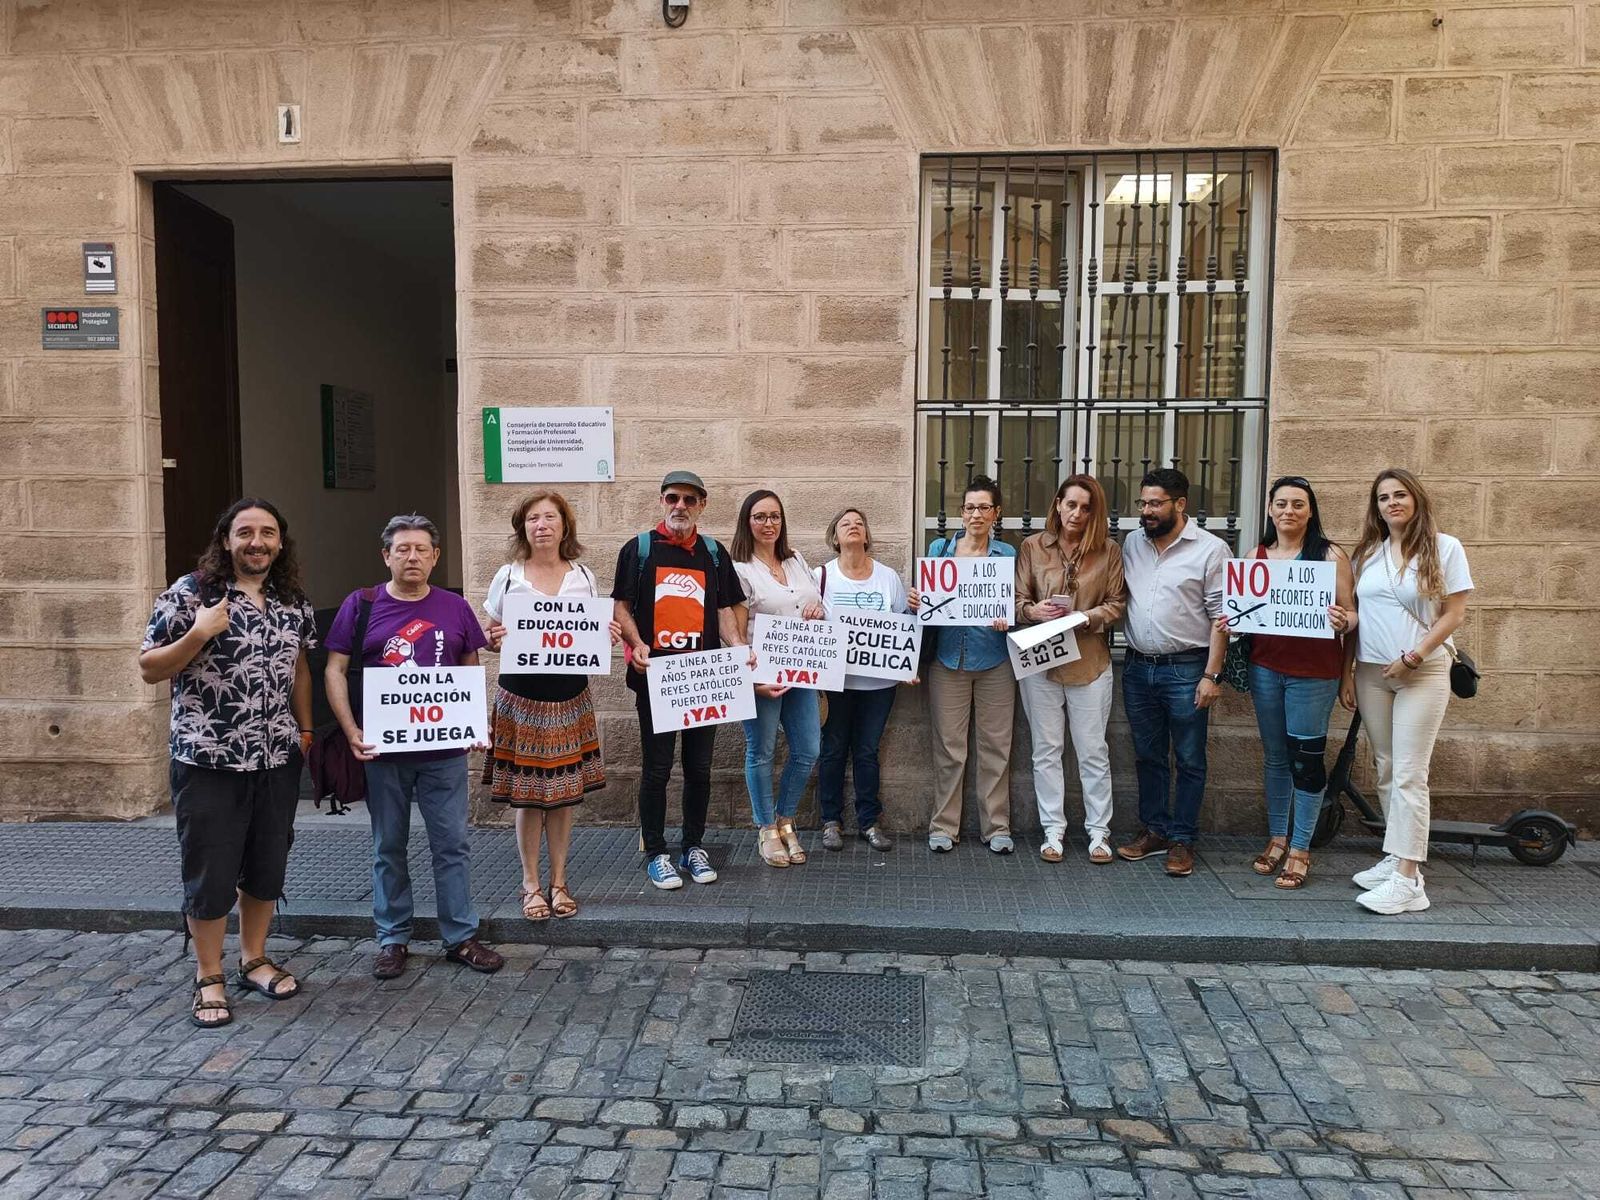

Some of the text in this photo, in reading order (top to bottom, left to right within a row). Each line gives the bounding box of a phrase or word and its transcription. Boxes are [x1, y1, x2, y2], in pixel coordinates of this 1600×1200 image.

[507, 421, 537, 429] Consejería
[507, 438, 538, 446] Consejería
[920, 559, 996, 592] NO A LOS
[1227, 561, 1315, 597] NO A LOS
[959, 584, 1012, 598] RECORTES EN
[1270, 589, 1332, 607] RECORTES EN
[534, 602, 585, 613] CON LA
[963, 600, 1007, 618] EDUCACIÓN
[518, 618, 599, 631] EDUCACIÓN
[785, 620, 809, 631] LÍNEA
[813, 624, 824, 634] DE
[828, 625, 832, 634] 3
[840, 615, 915, 632] SALVEMOS LA
[1275, 609, 1325, 629] EDUCACIÓN
[542, 632, 573, 648] NO
[657, 630, 702, 650] CGT
[765, 631, 837, 646] AÑOS PARA CEIP
[848, 630, 915, 652] SCUELA
[762, 643, 837, 658] REYES CATÓLICOS
[846, 647, 912, 671] ÚBLICA
[517, 653, 600, 667] SE JUEGA
[680, 656, 707, 668] LÍNEA
[711, 653, 722, 664] DE
[726, 652, 732, 662] 3
[769, 656, 828, 669] PUERTO REAL
[398, 673, 454, 684] CON LA
[661, 664, 739, 684] AÑOS PARA CEIP
[776, 669, 819, 684] ¡YA!
[660, 677, 742, 697] REYES CATÓLICOS
[381, 688, 471, 705] EDUCACIÓN
[671, 691, 735, 708] PUERTO REAL
[410, 705, 443, 723] NO
[684, 704, 726, 726] ¡YA!
[383, 726, 475, 744] SE JUEGA
